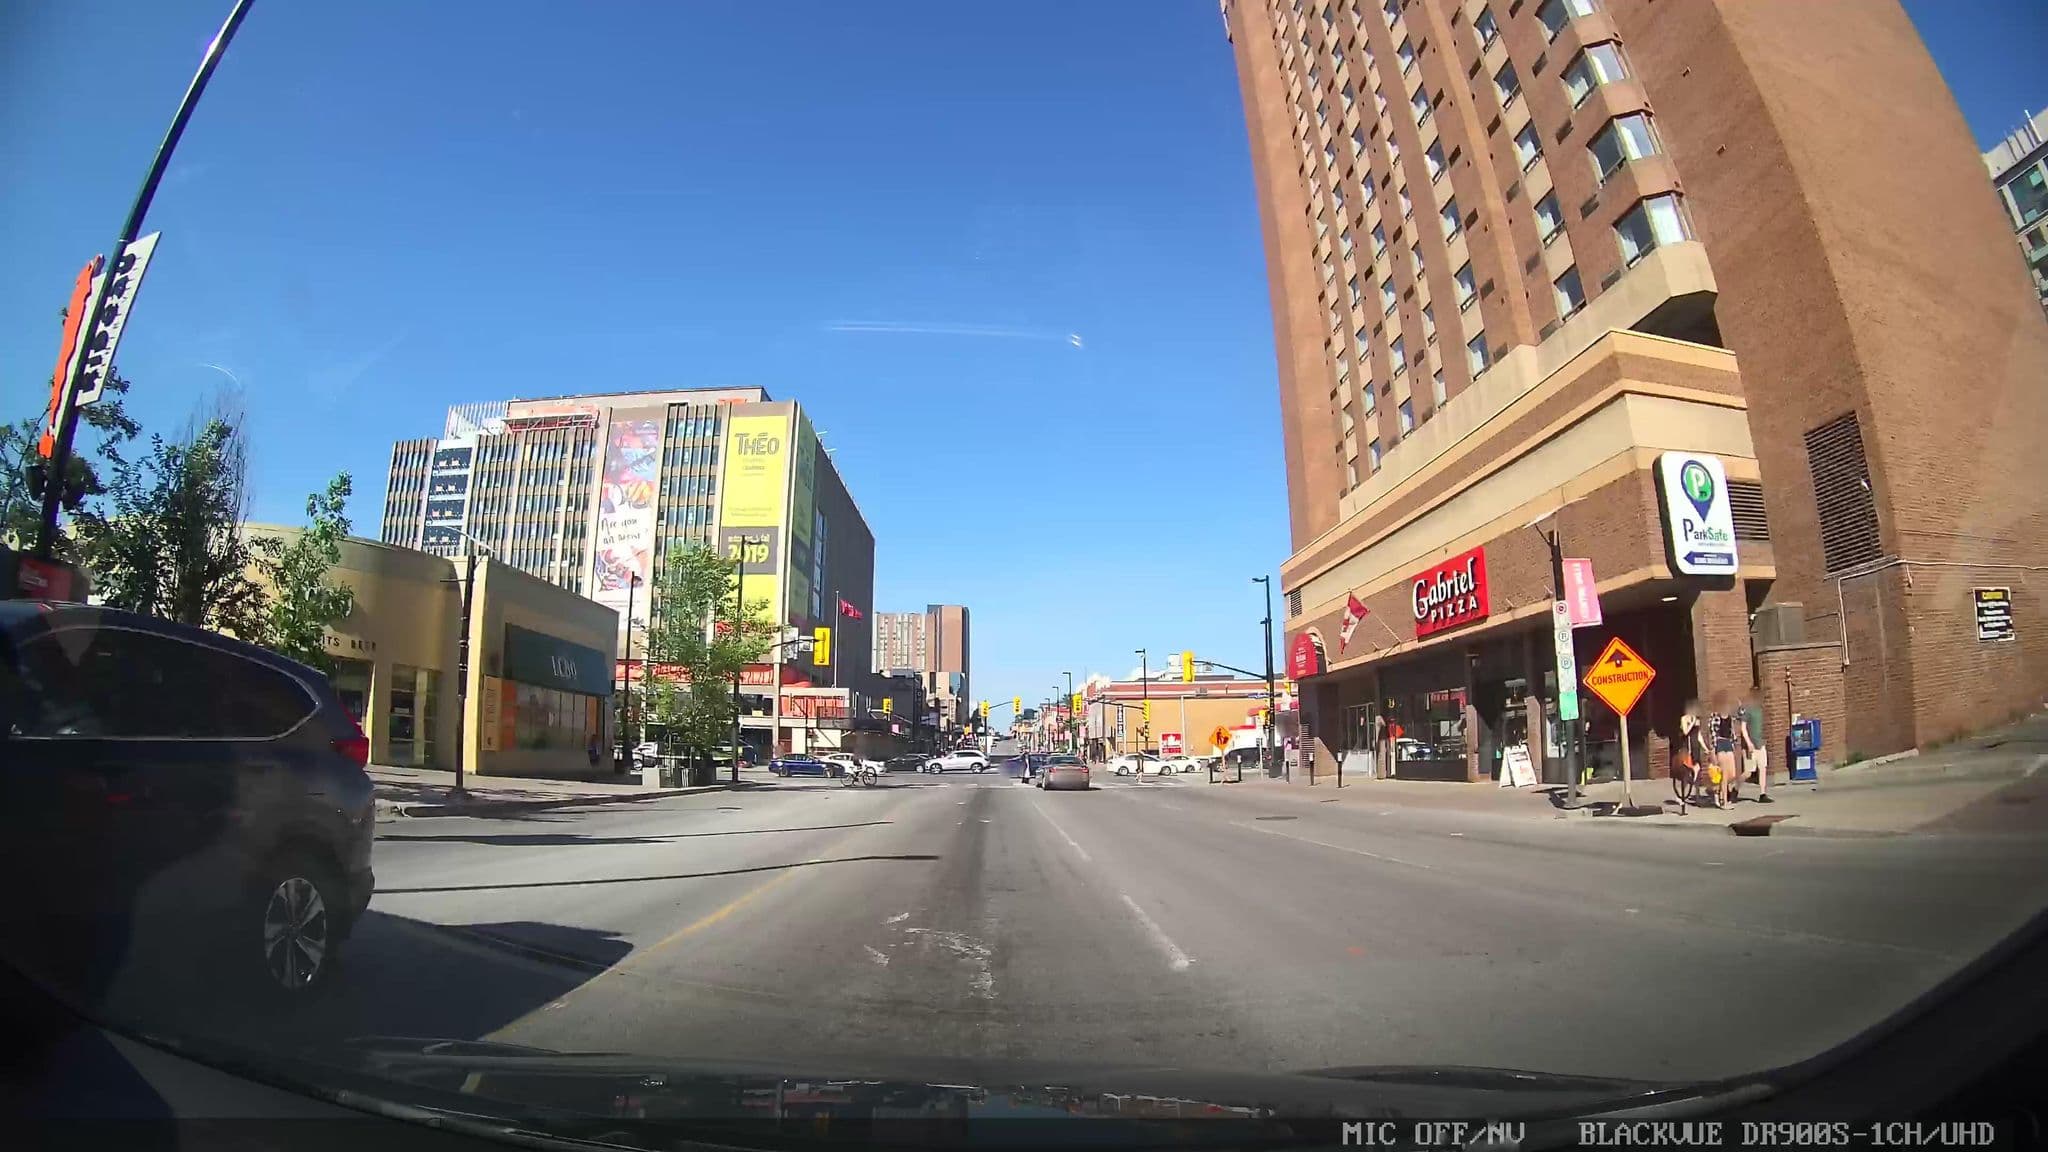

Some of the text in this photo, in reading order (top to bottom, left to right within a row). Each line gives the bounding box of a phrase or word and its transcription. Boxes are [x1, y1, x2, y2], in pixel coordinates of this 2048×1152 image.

[1413, 557, 1475, 619] Gabriel
[1431, 595, 1477, 623] PIZZA
[1591, 670, 1649, 686] CONSTRUCTION
